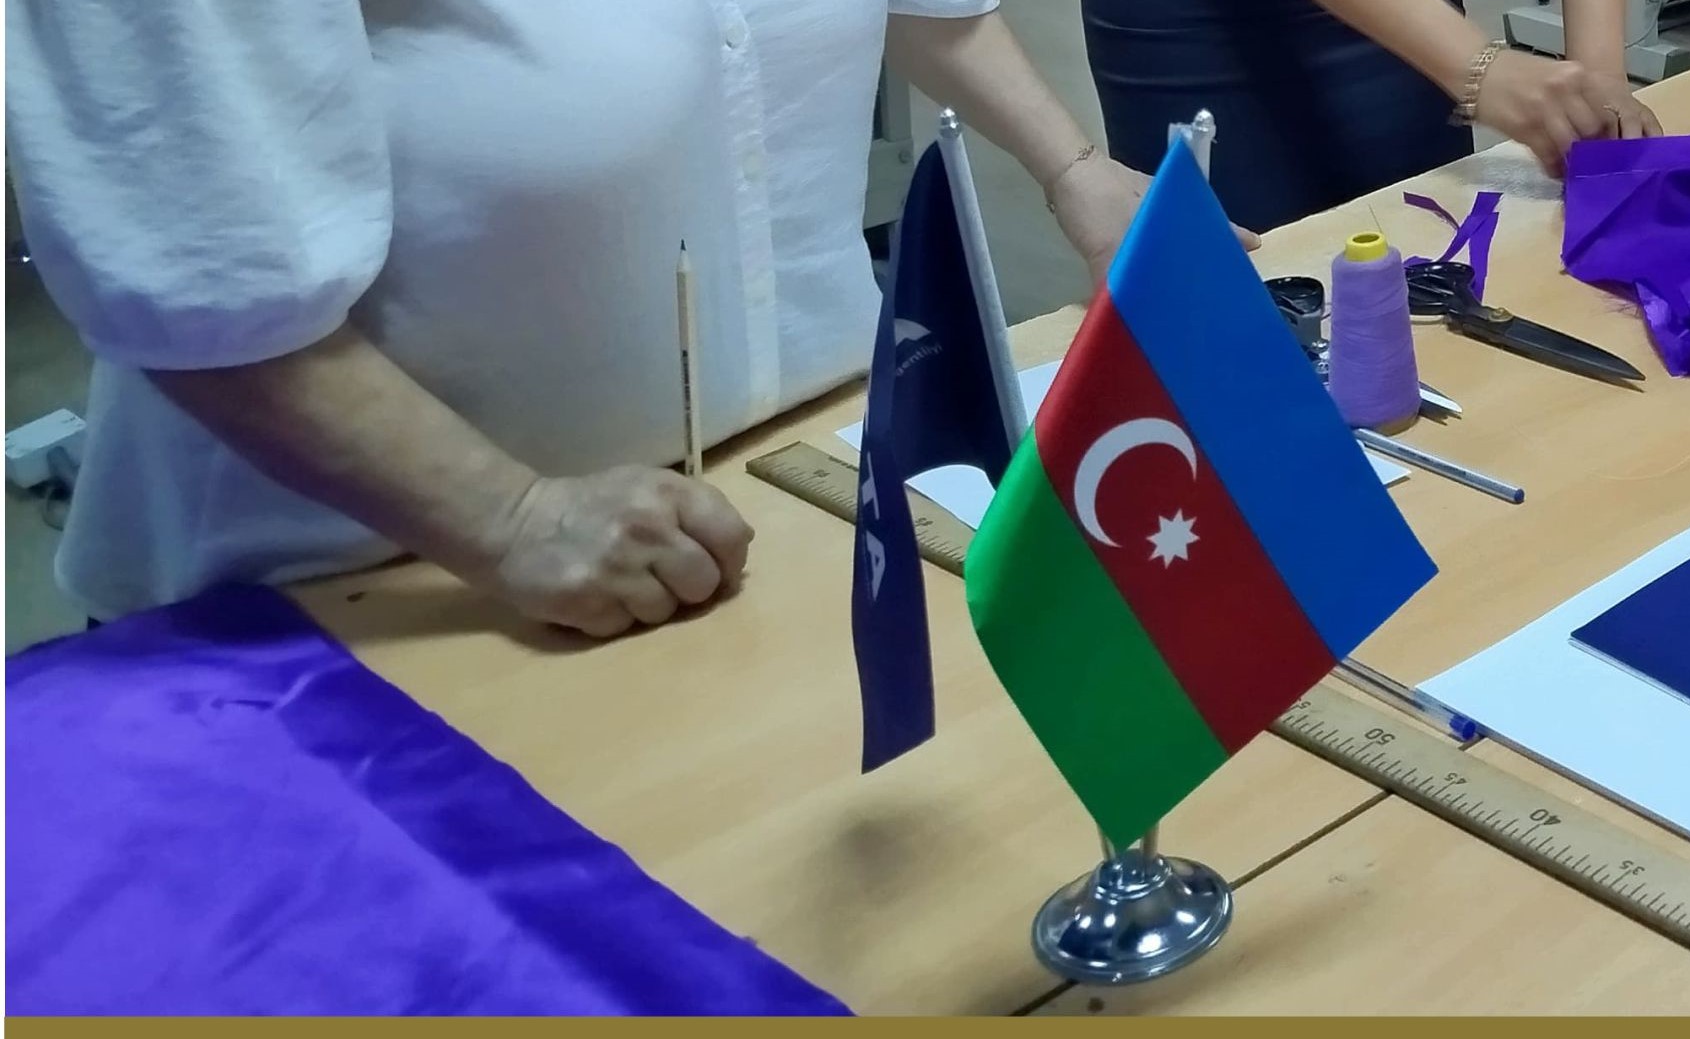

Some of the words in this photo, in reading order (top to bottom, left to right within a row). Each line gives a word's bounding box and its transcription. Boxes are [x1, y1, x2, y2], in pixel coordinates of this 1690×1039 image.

[1365, 727, 1396, 746] 50
[1447, 771, 1468, 786] 45
[1529, 808, 1562, 827] 40
[1621, 859, 1646, 876] 35
